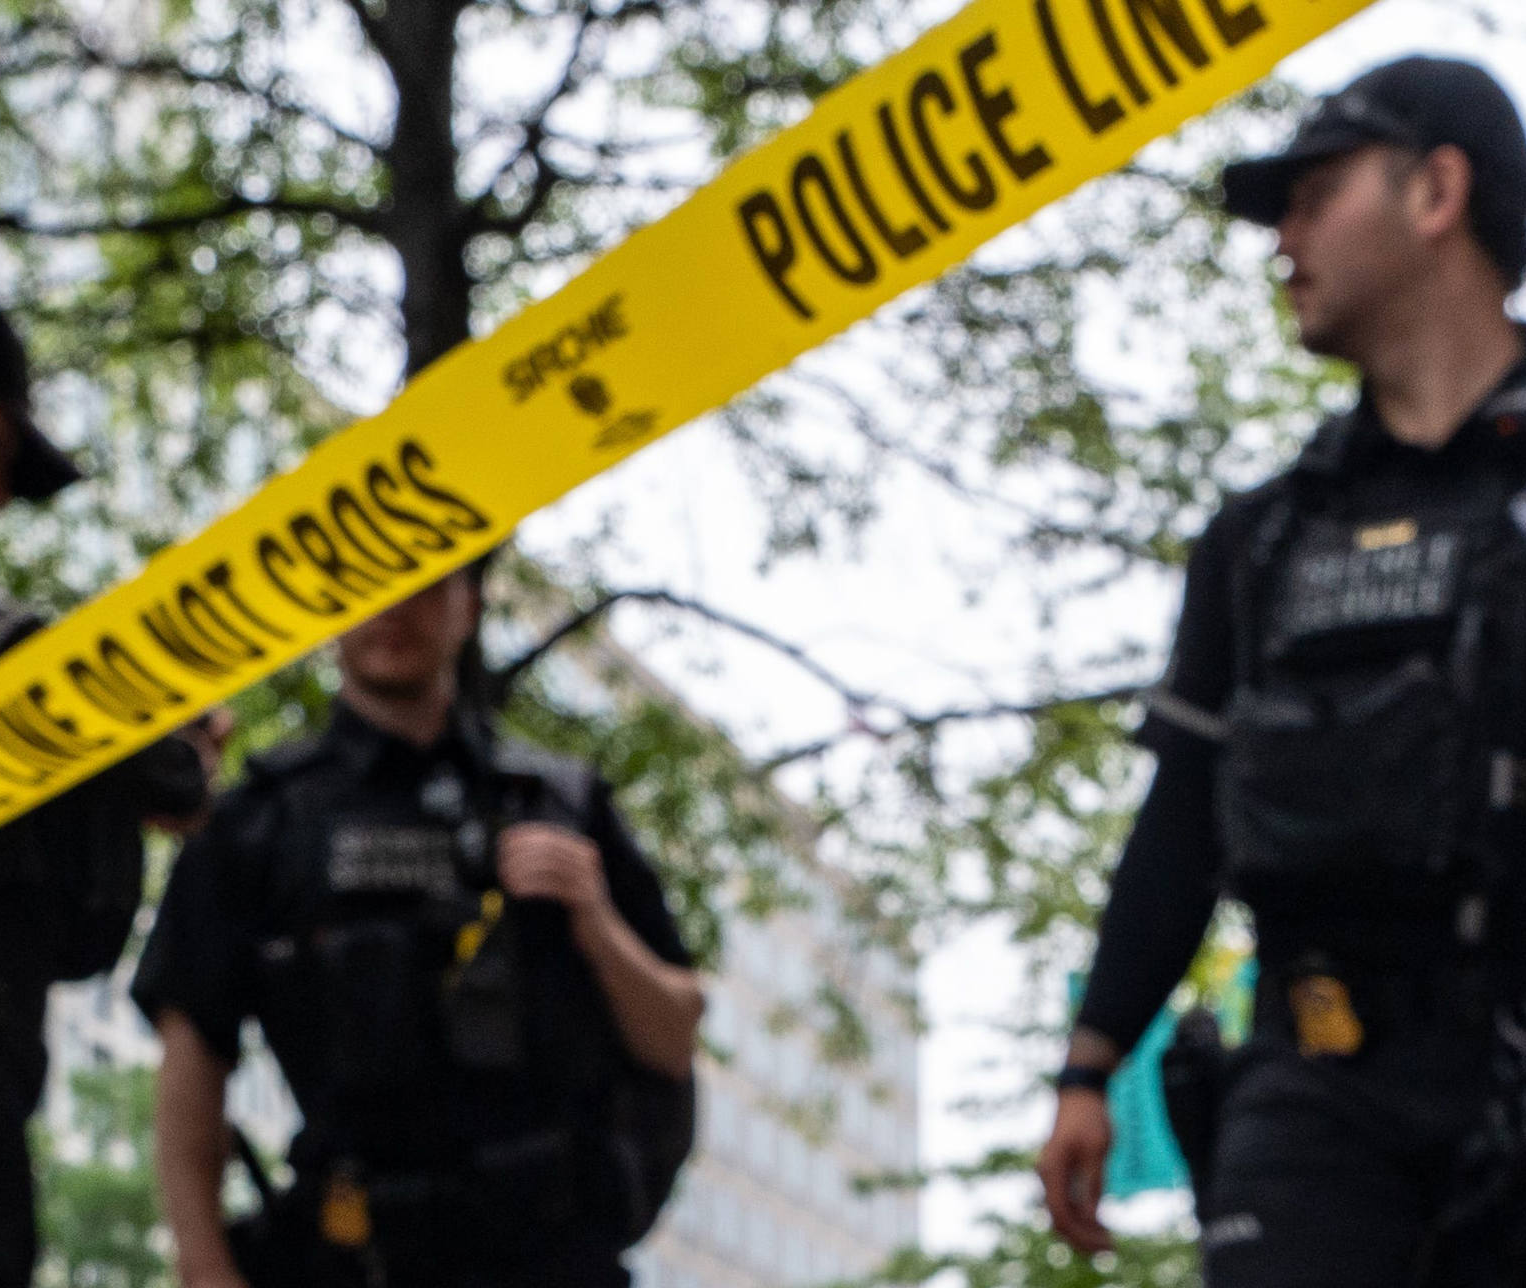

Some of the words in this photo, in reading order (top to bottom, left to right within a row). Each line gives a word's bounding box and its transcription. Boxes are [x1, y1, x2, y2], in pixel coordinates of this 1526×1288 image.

[737, 30, 1055, 322] POLICE
[63, 634, 190, 728] DO
[138, 559, 295, 682] NOT
[253, 437, 491, 619] CROSS
